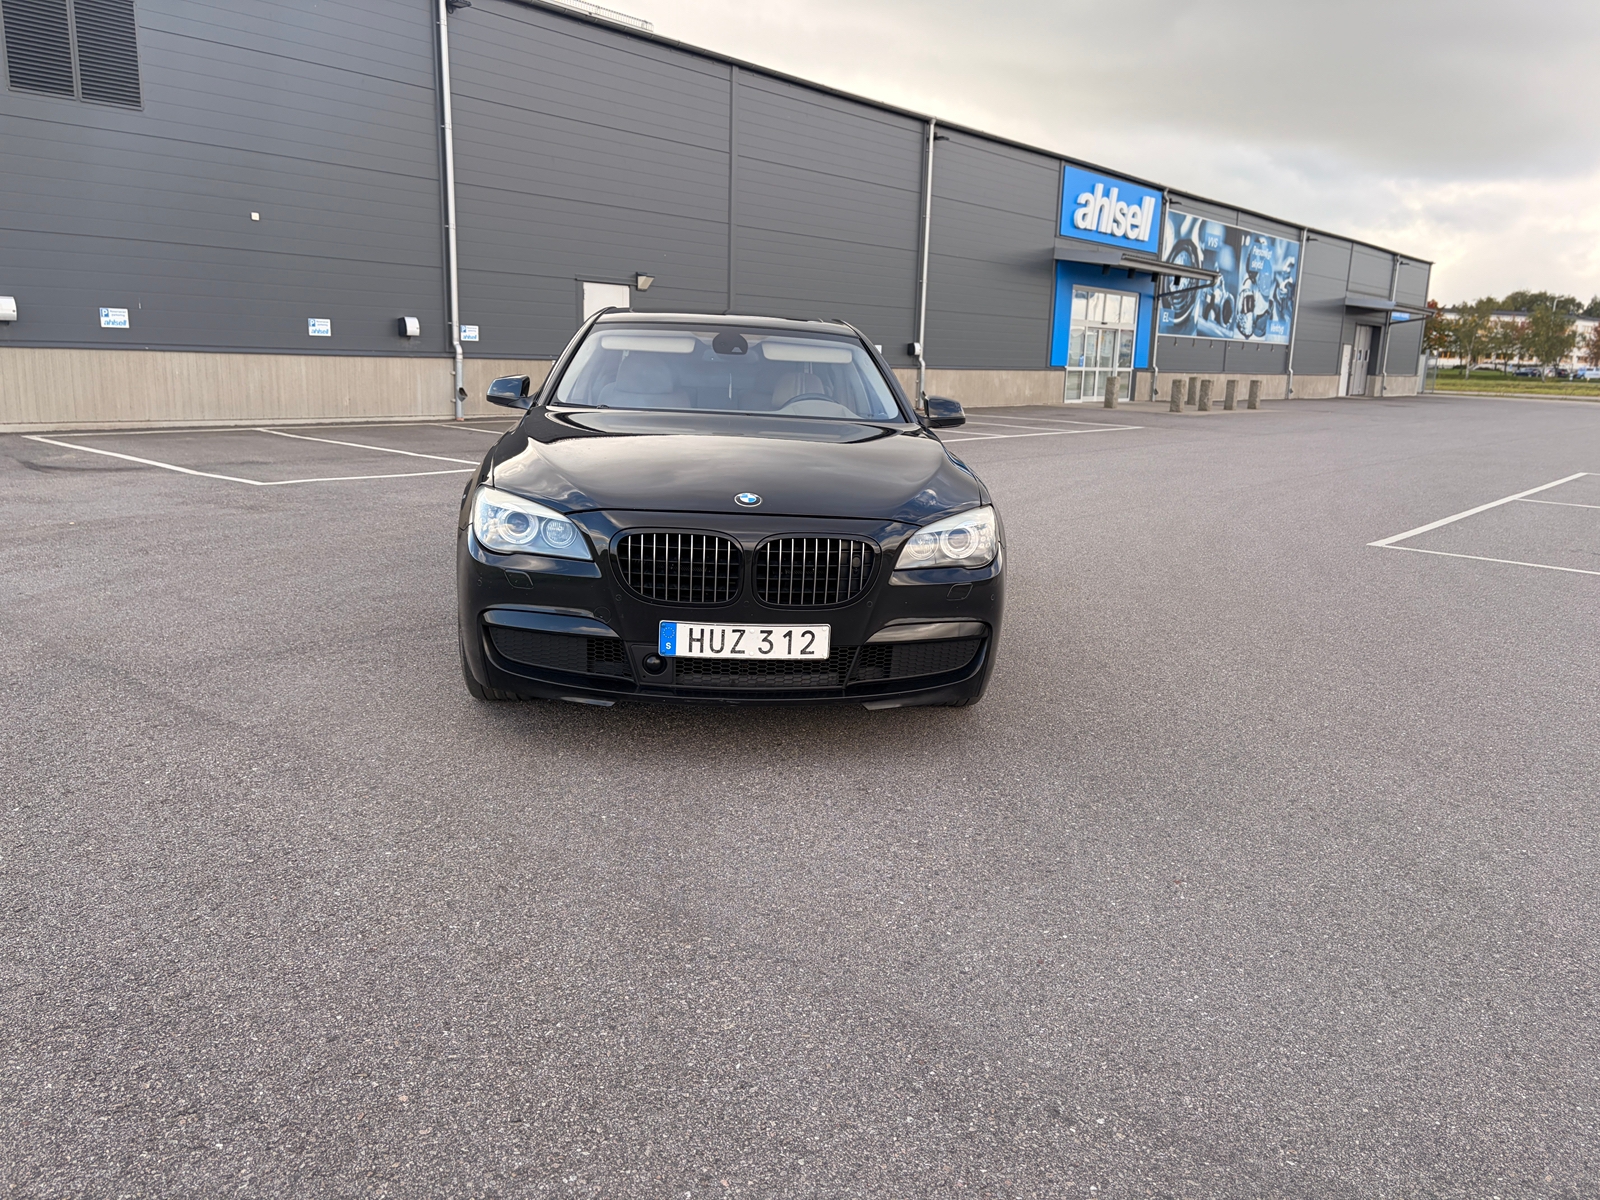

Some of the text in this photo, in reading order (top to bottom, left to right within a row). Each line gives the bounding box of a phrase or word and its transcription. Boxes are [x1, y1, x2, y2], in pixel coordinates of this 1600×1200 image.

[1074, 183, 1156, 242] ahlsell
[1207, 236, 1219, 248] VVS
[665, 642, 672, 650] S
[688, 627, 816, 655] HUZ 312
